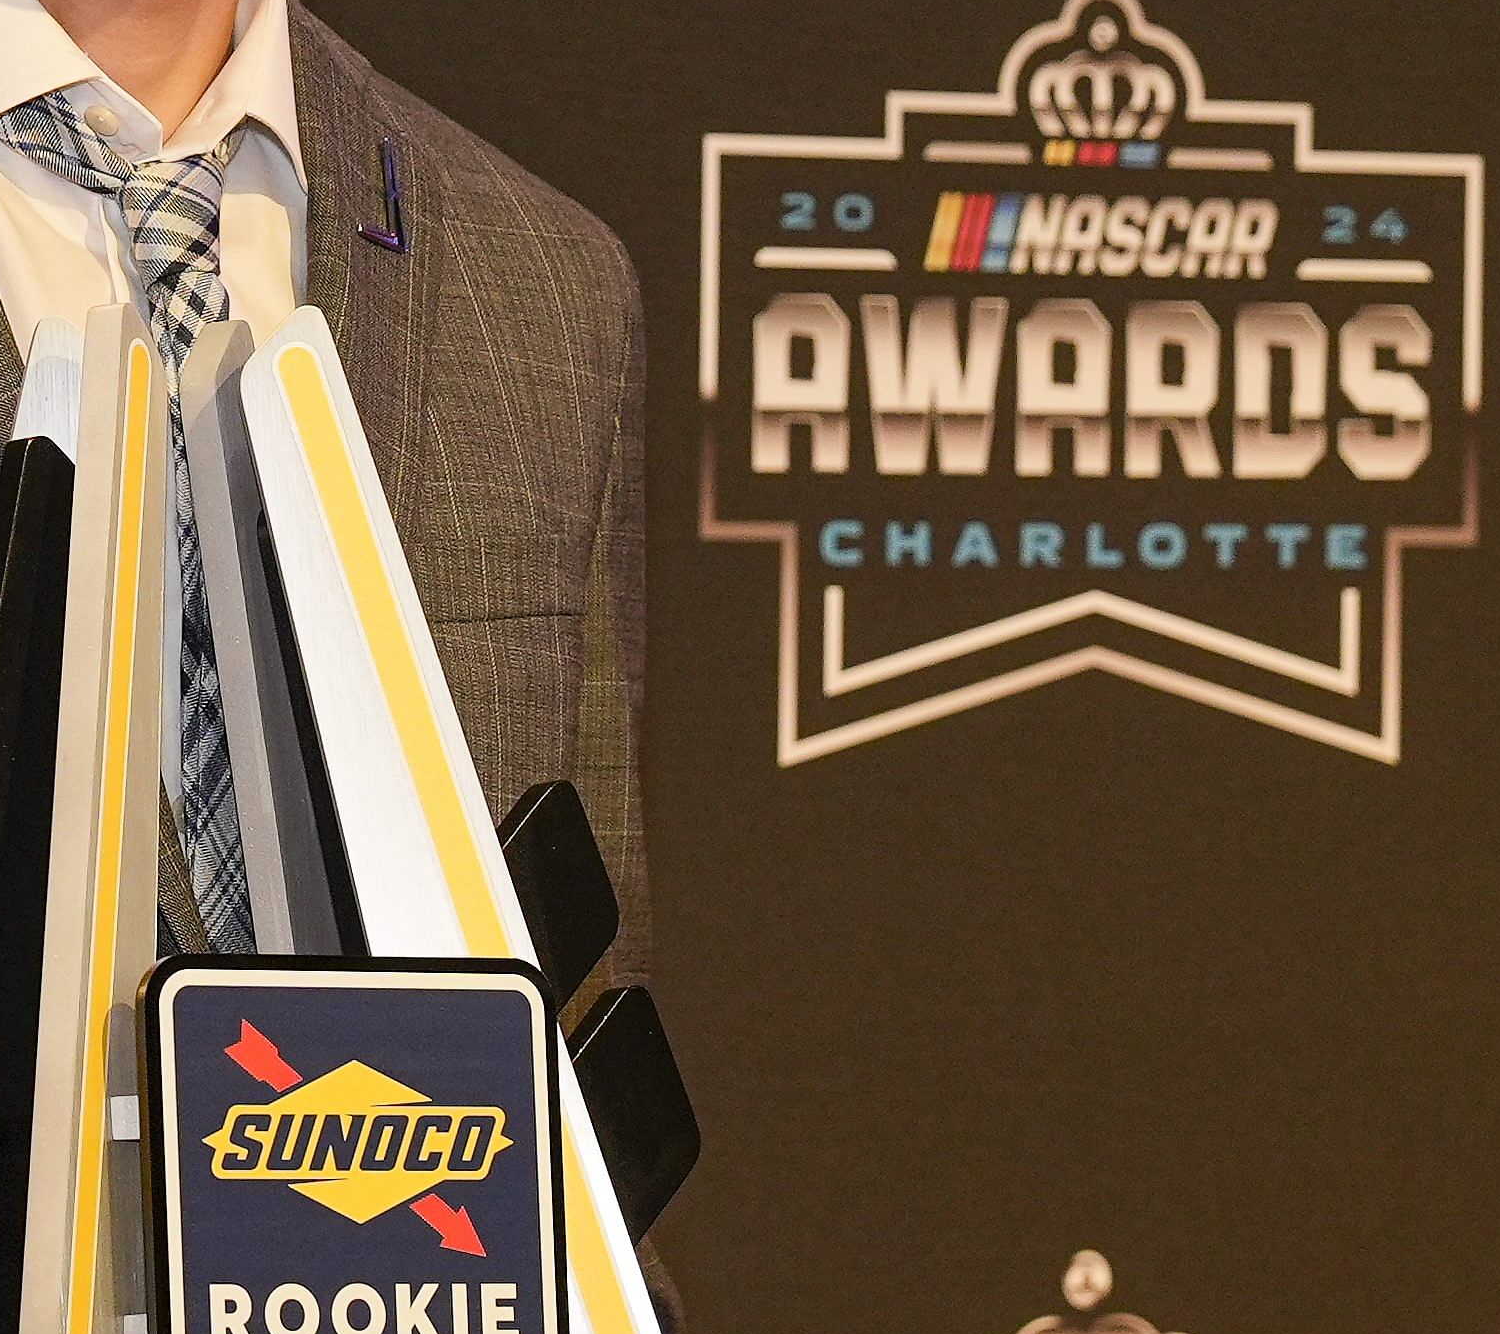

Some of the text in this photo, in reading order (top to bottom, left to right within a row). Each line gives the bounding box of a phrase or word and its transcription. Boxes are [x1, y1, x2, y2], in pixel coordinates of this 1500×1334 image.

[780, 190, 1411, 280] 20 NASCAR 24
[750, 293, 1434, 482] AWARDS
[818, 517, 1369, 571] CHARLOTTE
[221, 1115, 496, 1172] SUNOCO
